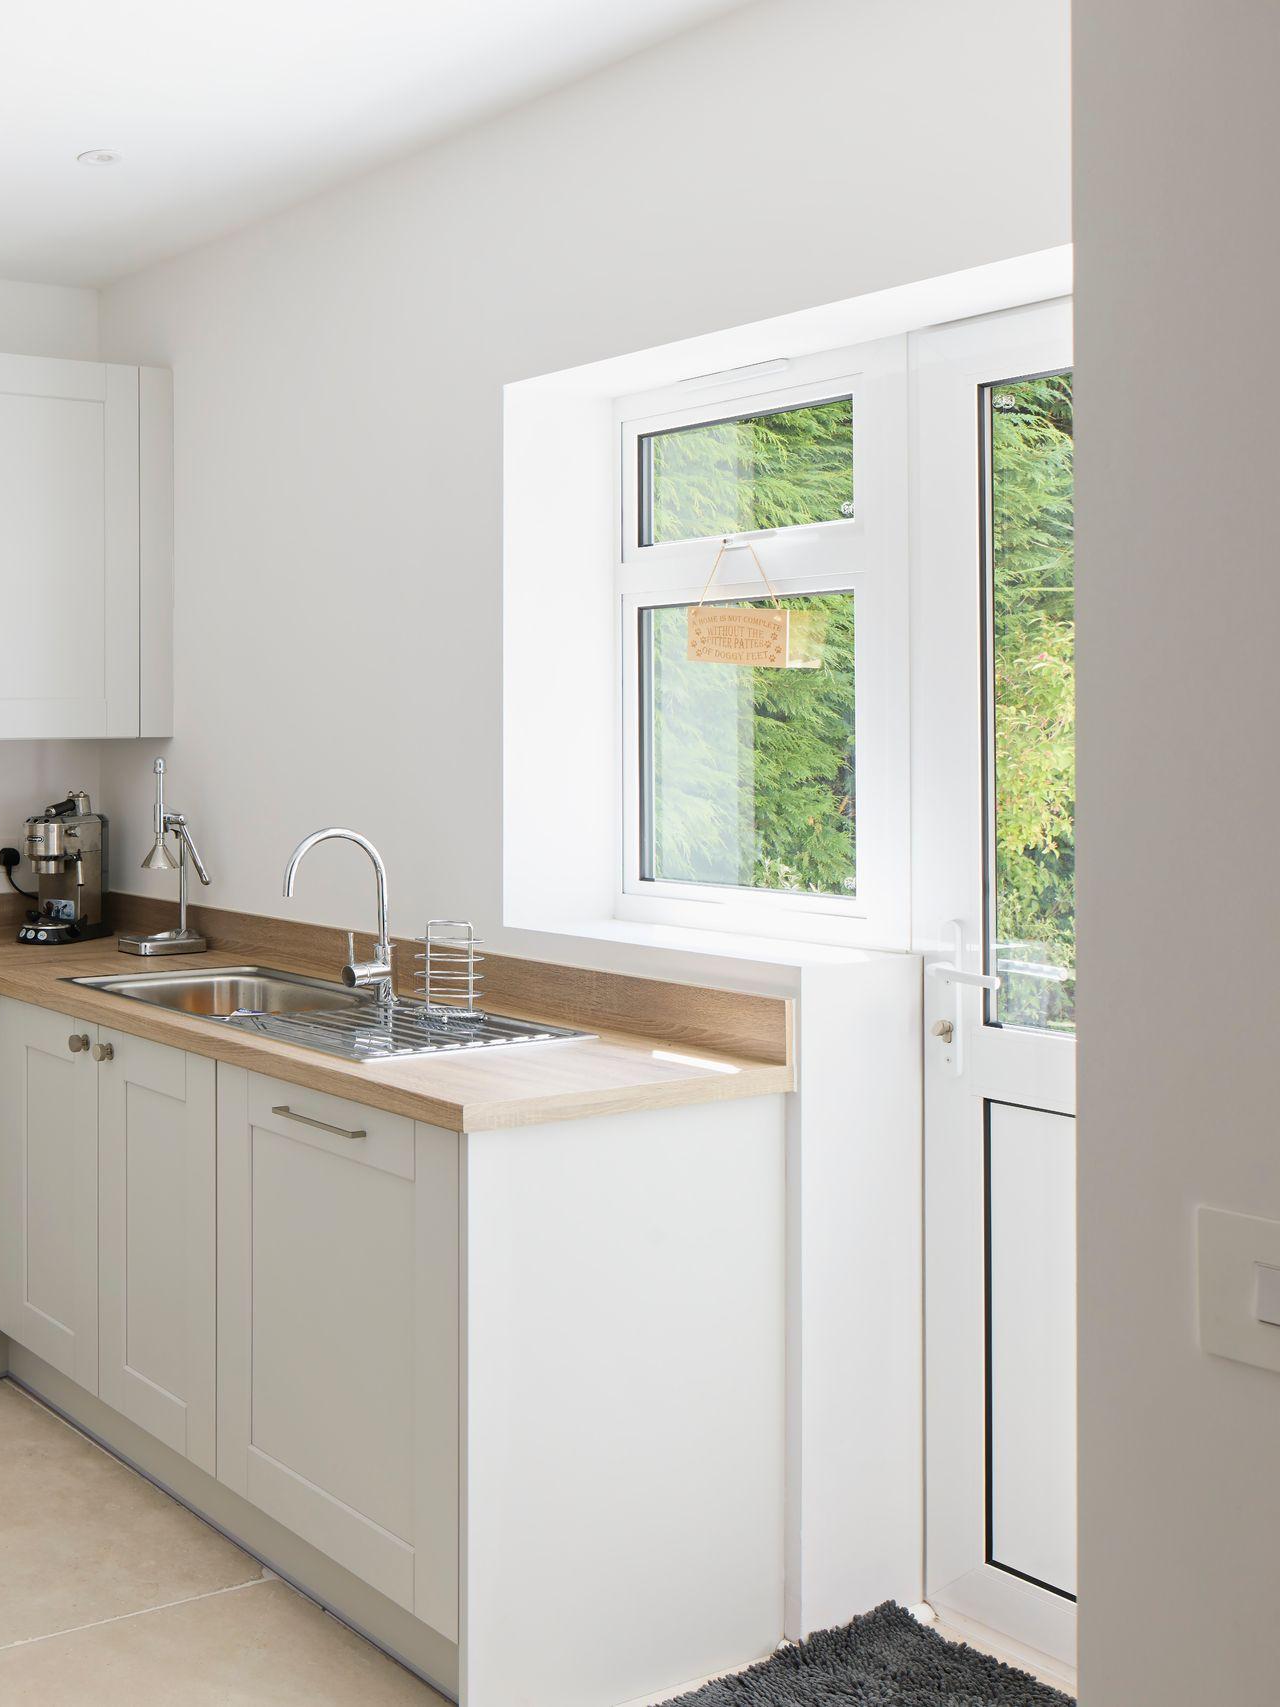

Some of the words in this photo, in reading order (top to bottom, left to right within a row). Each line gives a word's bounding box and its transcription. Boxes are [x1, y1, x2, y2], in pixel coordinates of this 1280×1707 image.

[698, 616, 717, 624] HOME
[744, 617, 783, 631] COMPLETE
[708, 626, 744, 637] WITHOUT
[749, 628, 765, 638] THE
[706, 637, 732, 648] PITTER
[735, 639, 764, 648] PATTER
[702, 647, 711, 655] OF
[715, 650, 742, 660] DOGGY
[747, 651, 768, 660] FEET
